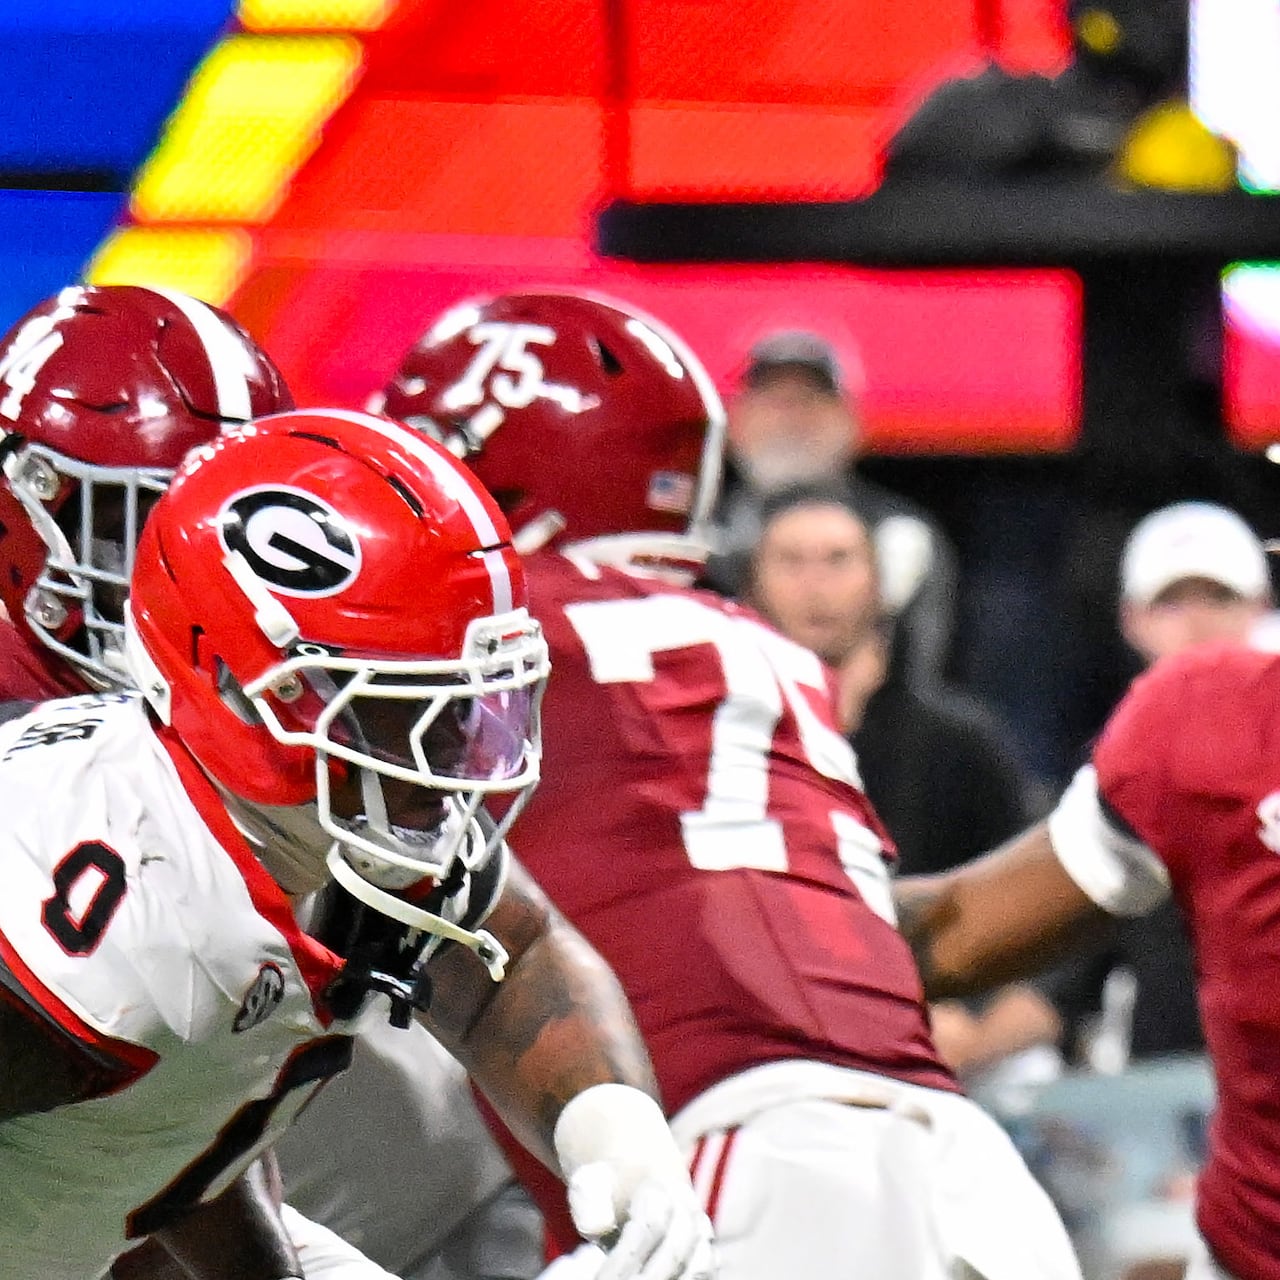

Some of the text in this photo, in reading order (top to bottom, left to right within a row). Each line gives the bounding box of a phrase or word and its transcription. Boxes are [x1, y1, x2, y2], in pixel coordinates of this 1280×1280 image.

[441, 321, 557, 410] 75
[215, 483, 362, 599] G
[41, 839, 128, 957] 0
